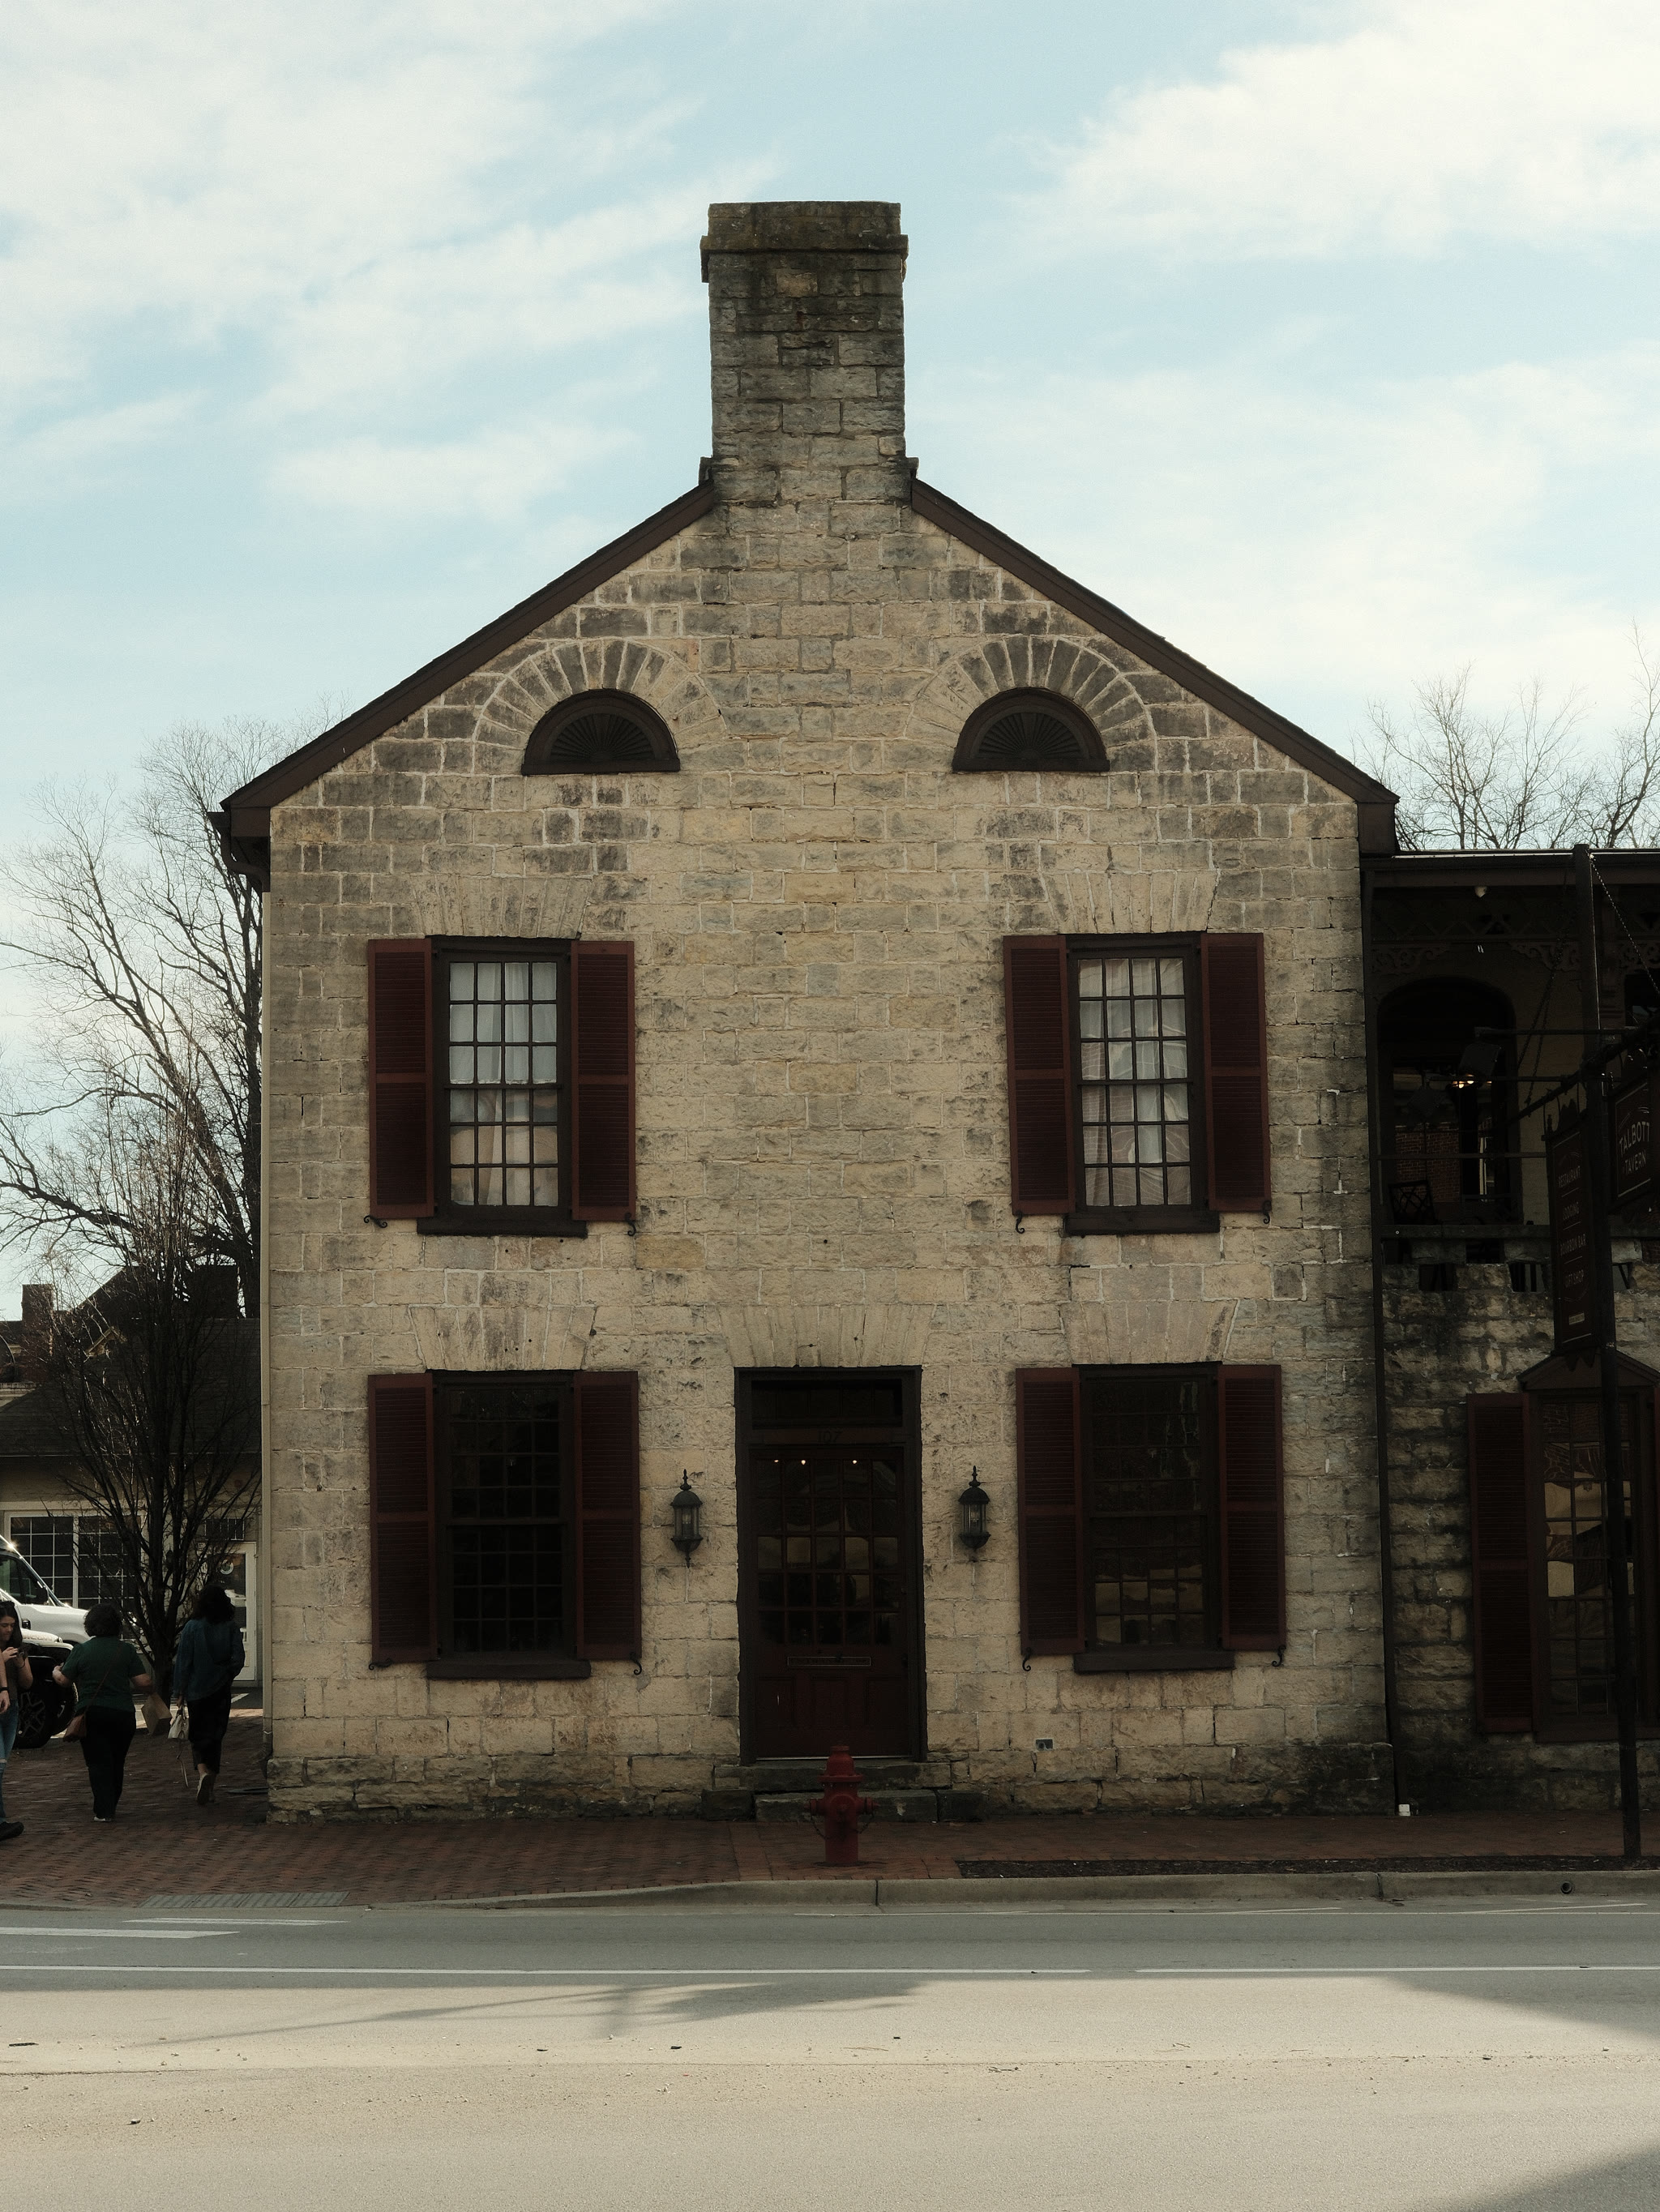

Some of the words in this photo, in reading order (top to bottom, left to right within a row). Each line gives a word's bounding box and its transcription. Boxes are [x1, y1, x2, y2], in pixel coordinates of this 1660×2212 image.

[1619, 1121, 1649, 1157] TALBOTT
[1625, 1149, 1646, 1175] TAVERN
[1558, 1166, 1581, 1187] RESTAURANT
[818, 1430, 843, 1444] 107
